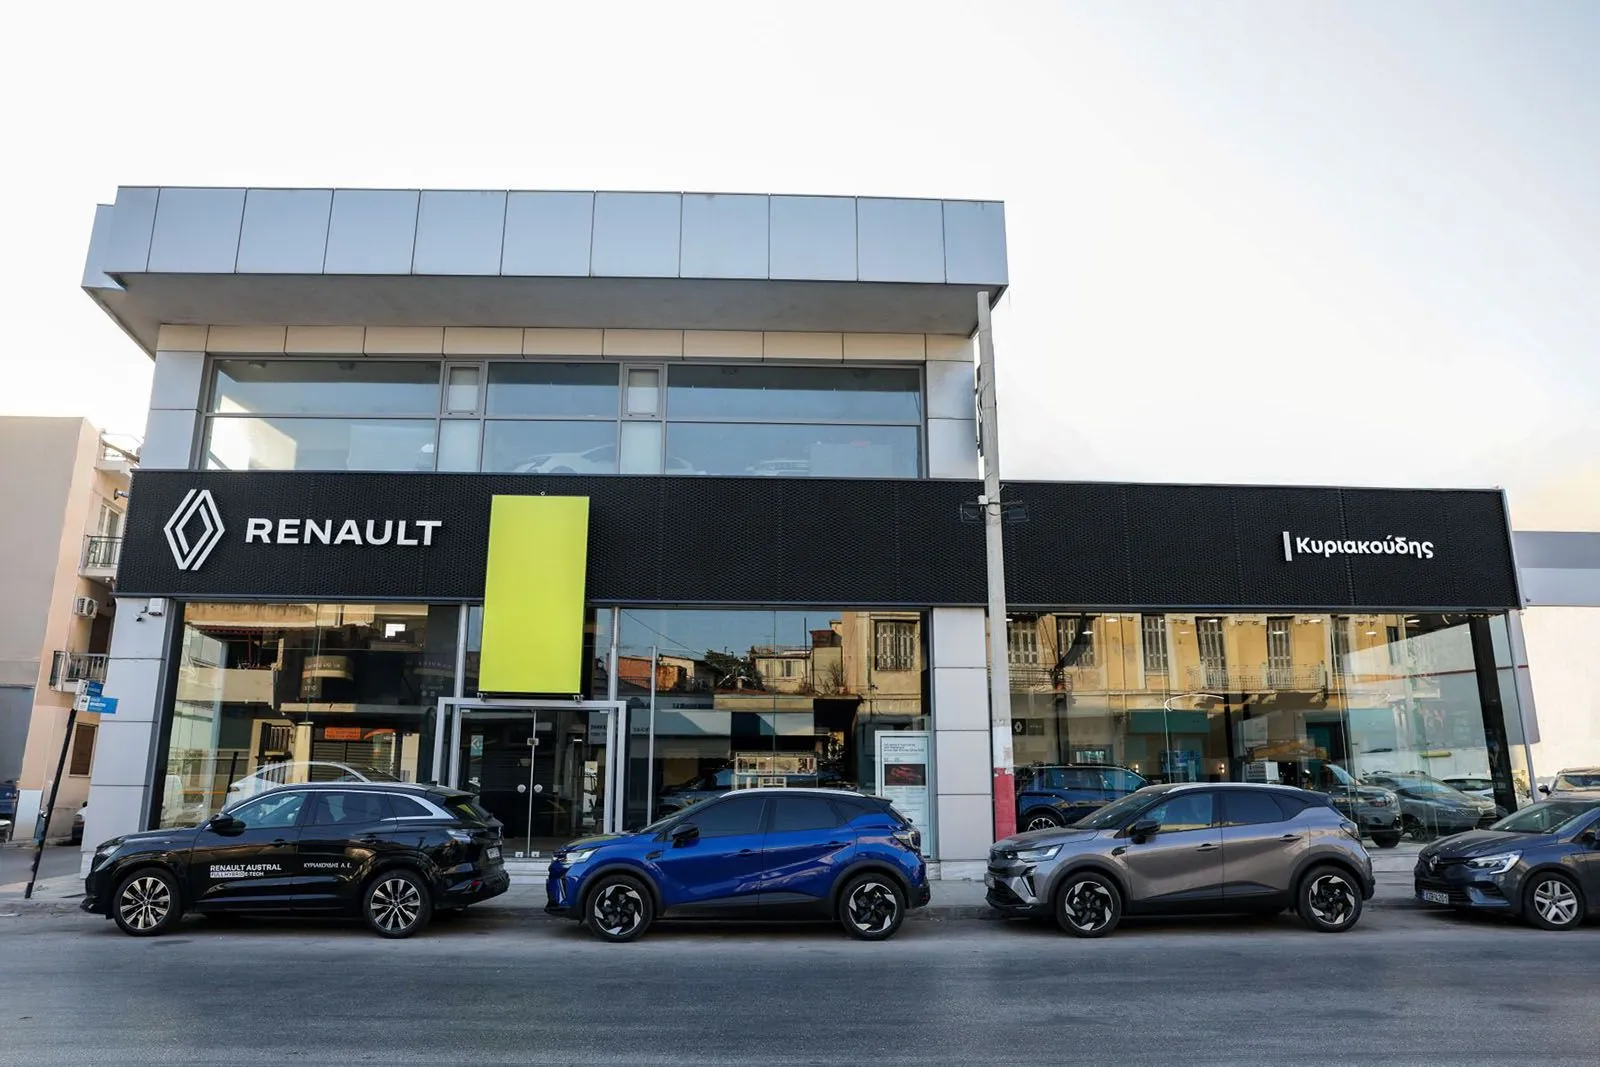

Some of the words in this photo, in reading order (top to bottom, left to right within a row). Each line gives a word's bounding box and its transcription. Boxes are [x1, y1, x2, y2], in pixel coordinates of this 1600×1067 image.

[245, 518, 442, 546] RENAULT
[1295, 534, 1434, 559] Κυριακούδης
[246, 863, 282, 871] AUSTRAL
